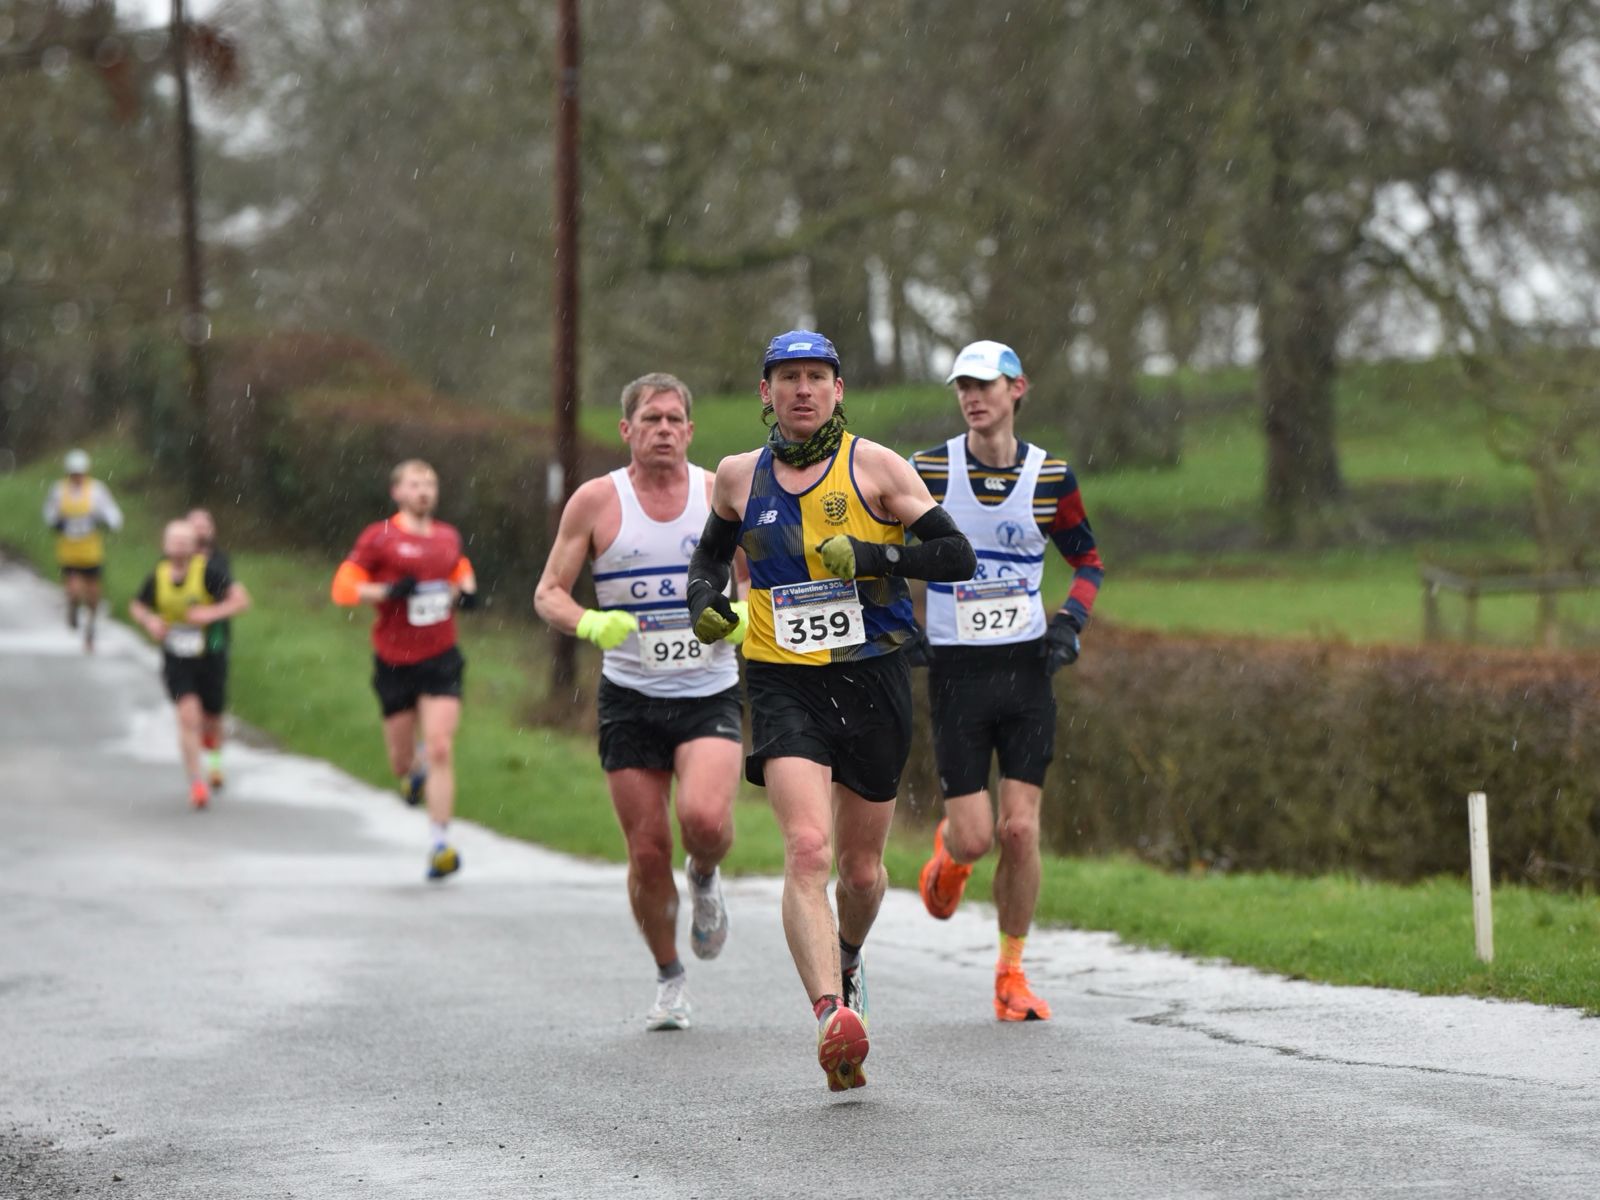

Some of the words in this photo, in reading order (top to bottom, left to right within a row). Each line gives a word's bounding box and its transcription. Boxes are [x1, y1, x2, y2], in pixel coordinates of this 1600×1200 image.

[631, 581, 647, 598] C
[659, 579, 676, 596] &
[789, 583, 829, 595] Valentine's
[787, 611, 850, 645] 359
[972, 608, 1018, 631] 927
[654, 639, 701, 662] 928
